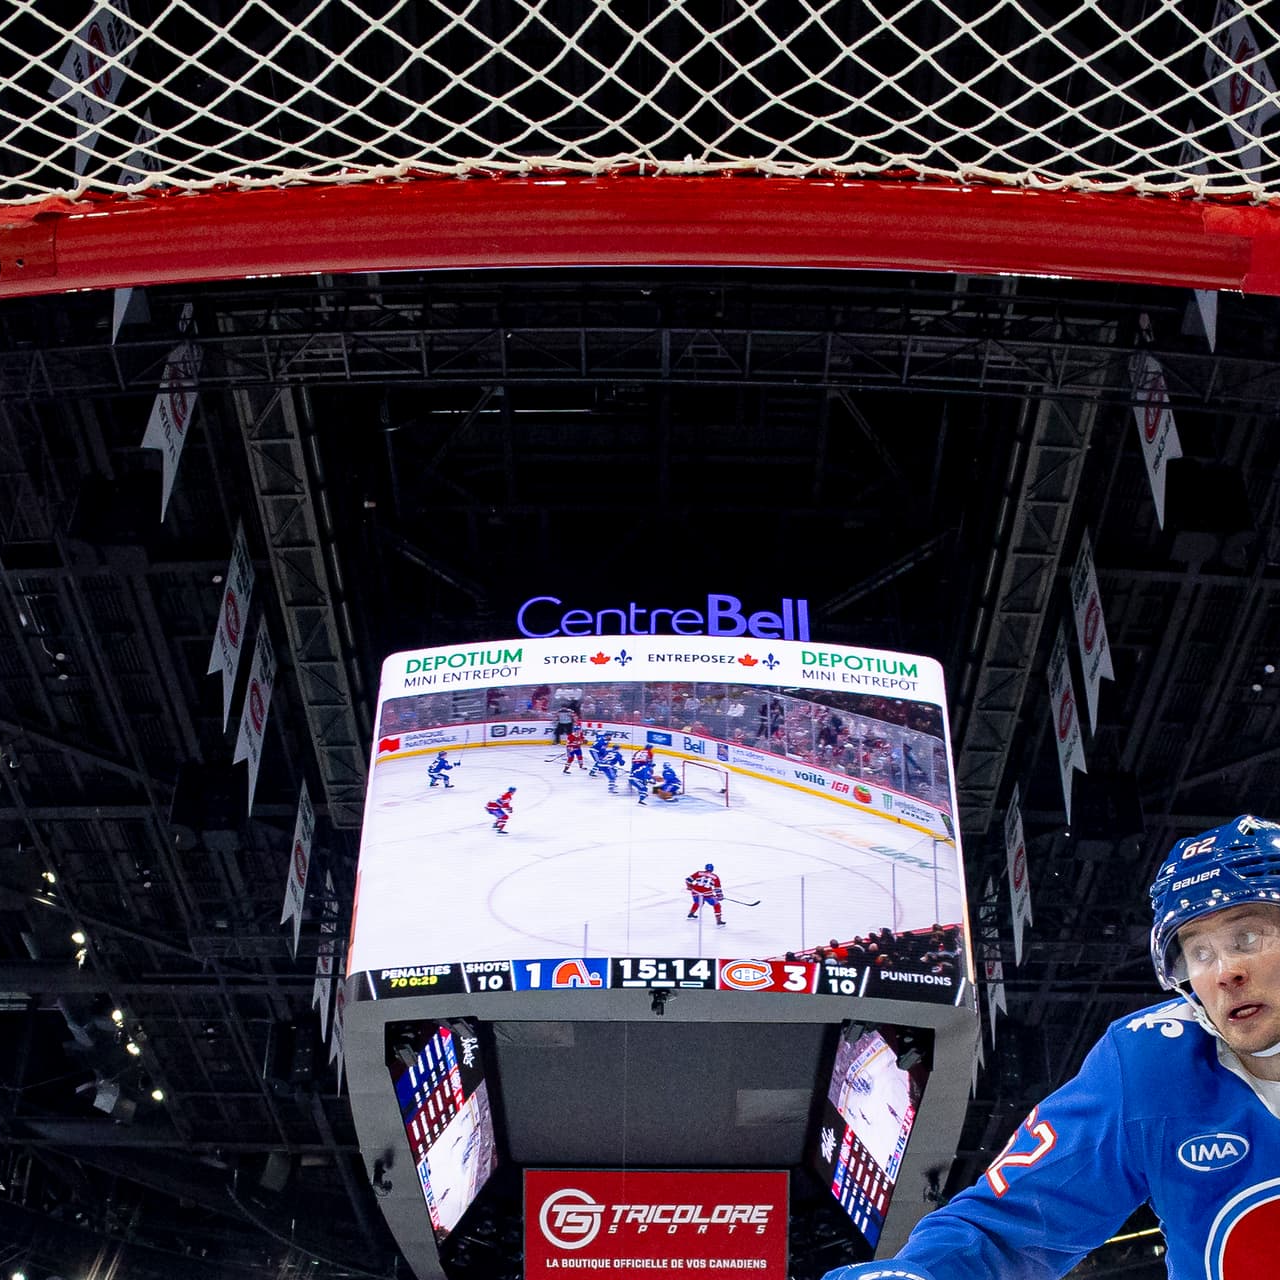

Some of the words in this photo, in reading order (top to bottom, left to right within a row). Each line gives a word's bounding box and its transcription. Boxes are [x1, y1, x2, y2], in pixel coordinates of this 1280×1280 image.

[405, 648, 523, 675] DEPOTIUM
[543, 654, 587, 665] STORE
[648, 653, 735, 665] ENTREPOSEZ
[800, 650, 918, 678] DEPOTIUM
[404, 675, 437, 688] MINI
[442, 666, 521, 684] ENTREPÔT
[801, 669, 836, 682] MINI
[841, 673, 918, 692] ENTREPÔT
[683, 736, 705, 755] Bell
[831, 781, 849, 794] IGA
[1182, 836, 1216, 860] 62
[1172, 869, 1221, 891] BAUER
[381, 964, 451, 980] PENALTIES
[466, 961, 509, 973] SHOTS
[525, 963, 541, 988] 1
[619, 959, 711, 980] 15:14
[826, 966, 858, 978] TIRS
[390, 977, 409, 988] 70
[477, 975, 503, 990] 10
[783, 965, 807, 990] 3
[829, 978, 855, 994] 10
[880, 970, 952, 986] PUNITIONS
[1191, 1142, 1239, 1162] IMA
[611, 1205, 774, 1224] TRICOLORE
[608, 1224, 766, 1234] SPORTS
[546, 1258, 559, 1268] LA
[562, 1258, 611, 1270] BOUTIQUE
[613, 1259, 668, 1269] OFFICIELLE
[671, 1259, 684, 1269] DE
[686, 1259, 707, 1269] VOS
[709, 1259, 767, 1269] CANADIENS
